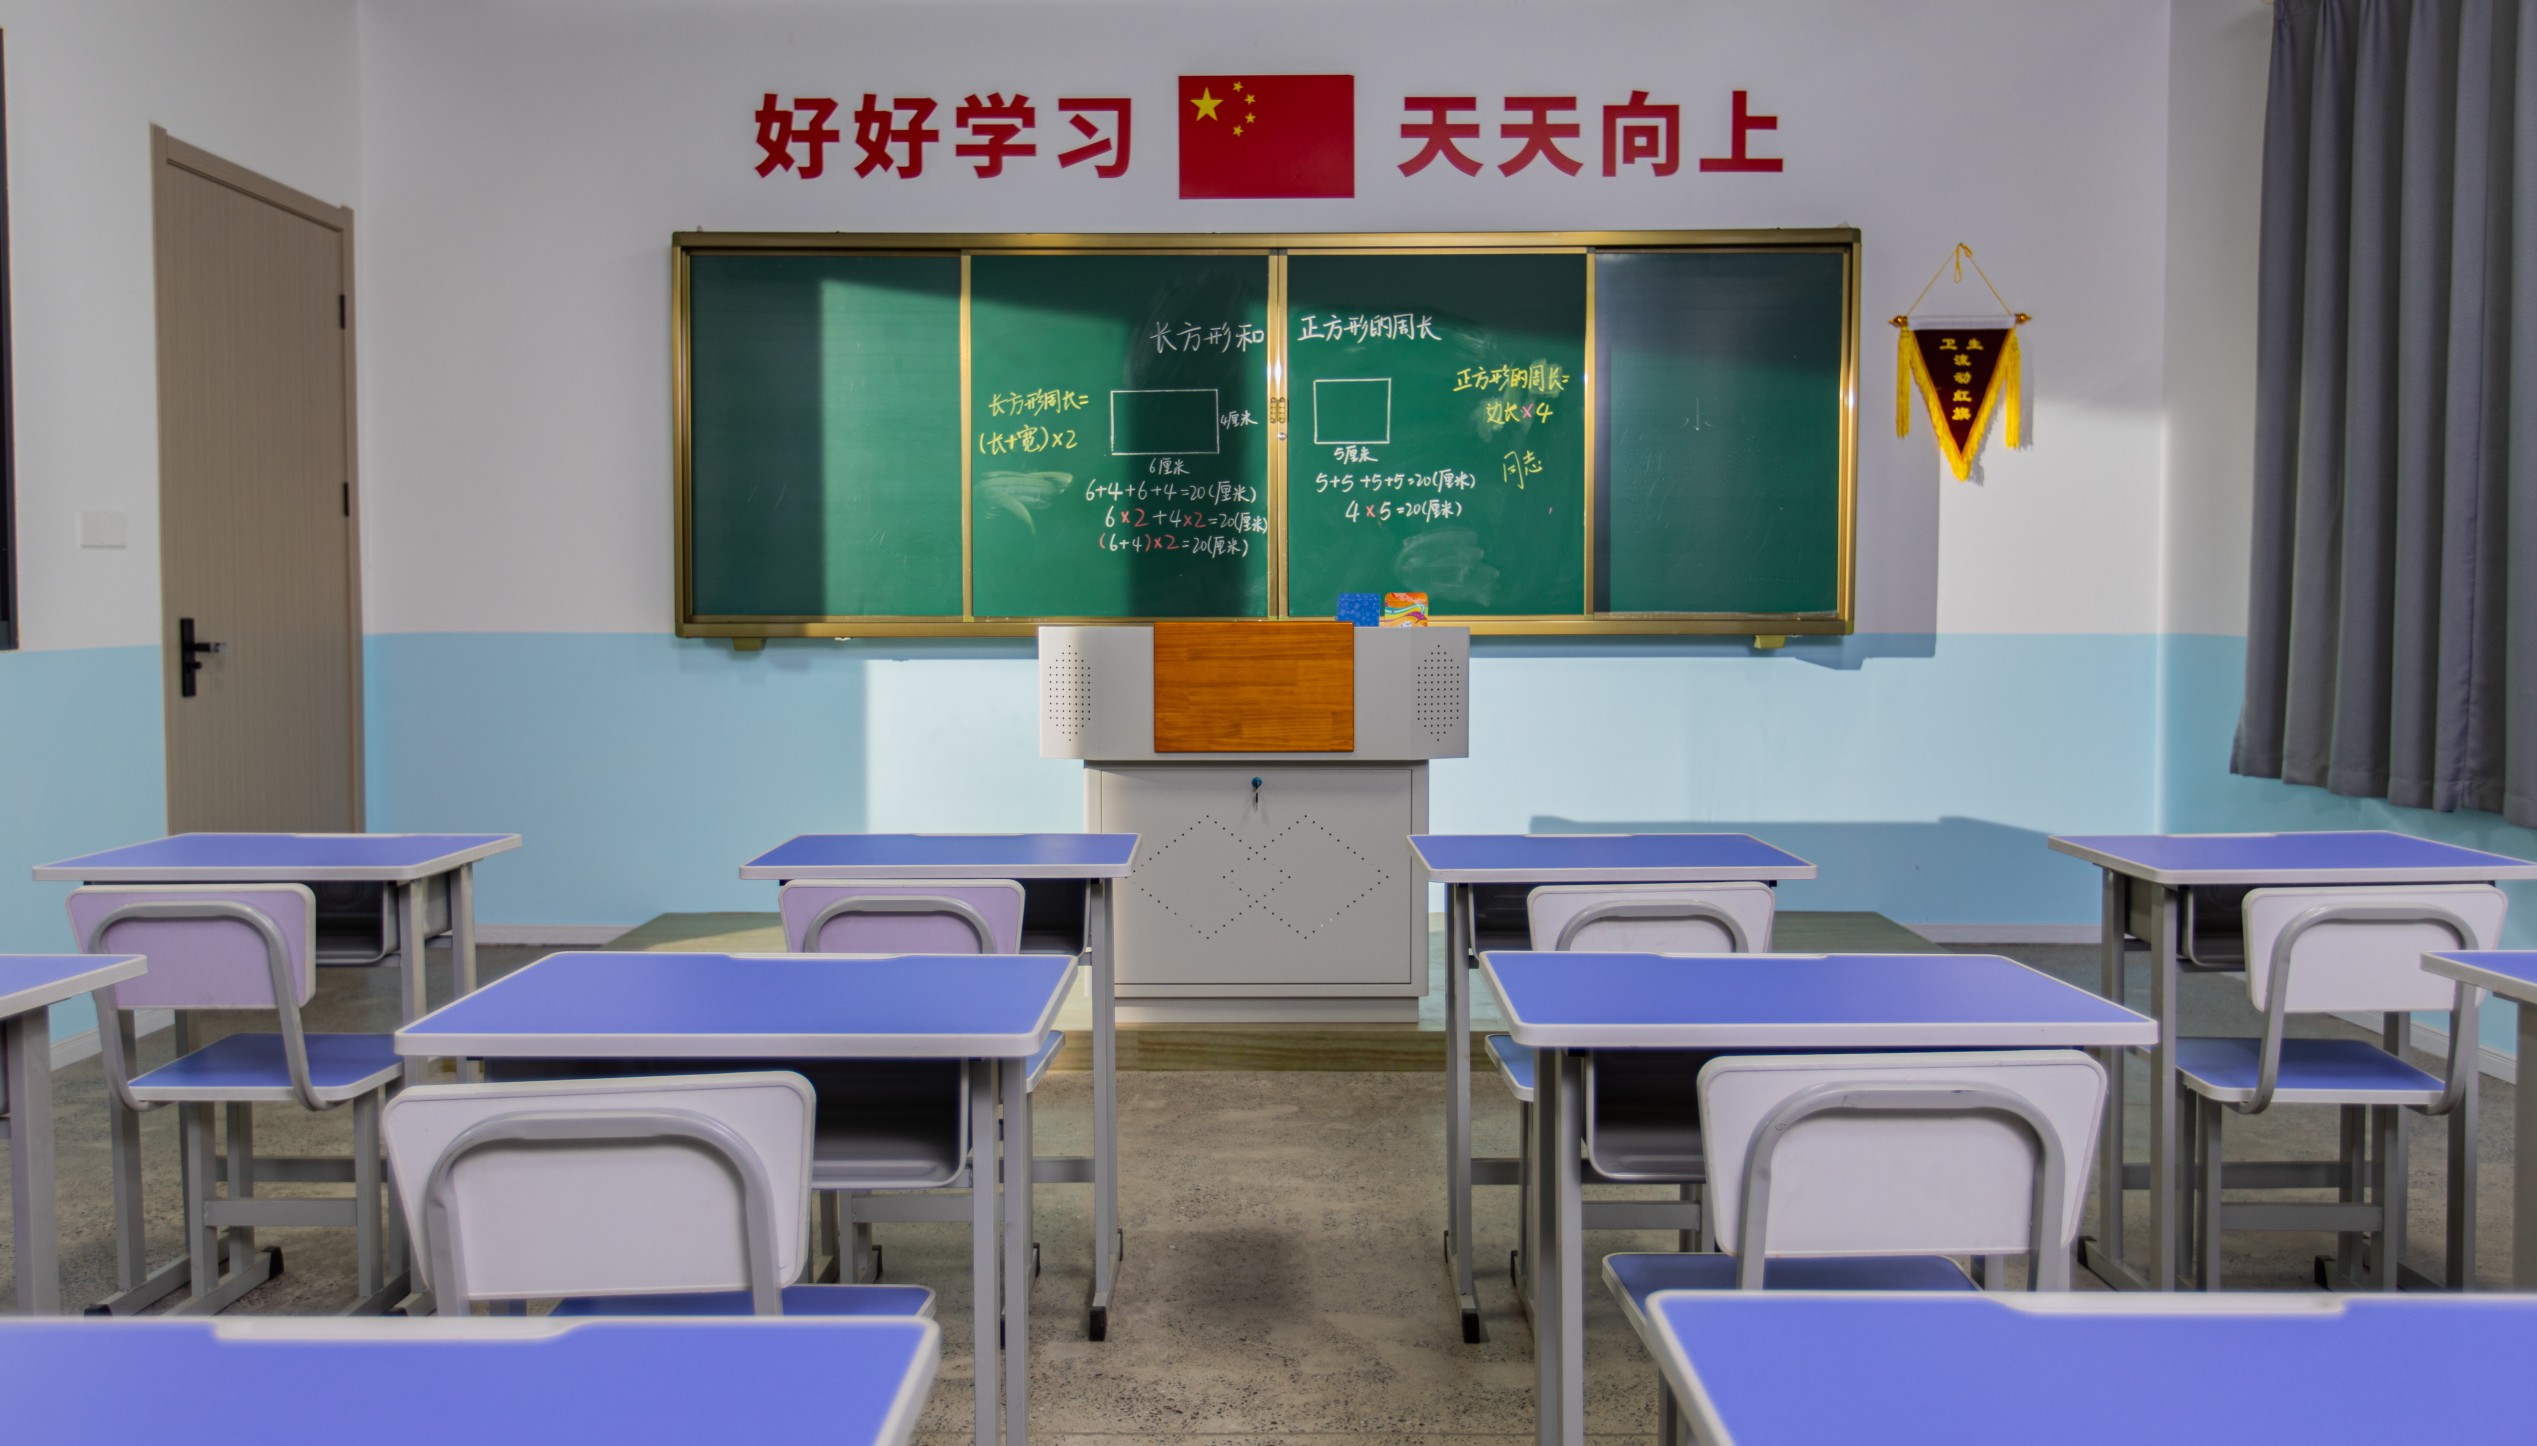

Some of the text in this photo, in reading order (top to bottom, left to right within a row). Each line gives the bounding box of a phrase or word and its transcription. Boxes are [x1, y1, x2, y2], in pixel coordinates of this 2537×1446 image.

[755, 92, 1134, 179] 好好学习
[1398, 89, 1784, 178] 天天向上
[1149, 321, 1265, 354] 长方形和
[1297, 313, 1442, 343] 正方形的周长
[1939, 338, 1984, 351] 卫生
[1452, 364, 1570, 392] 正方形的周长=
[988, 388, 1089, 417] 长方形周长=
[1220, 409, 1259, 430] 4厘米
[1149, 457, 1191, 476] 6厘米
[1333, 445, 1379, 465] 5厘米
